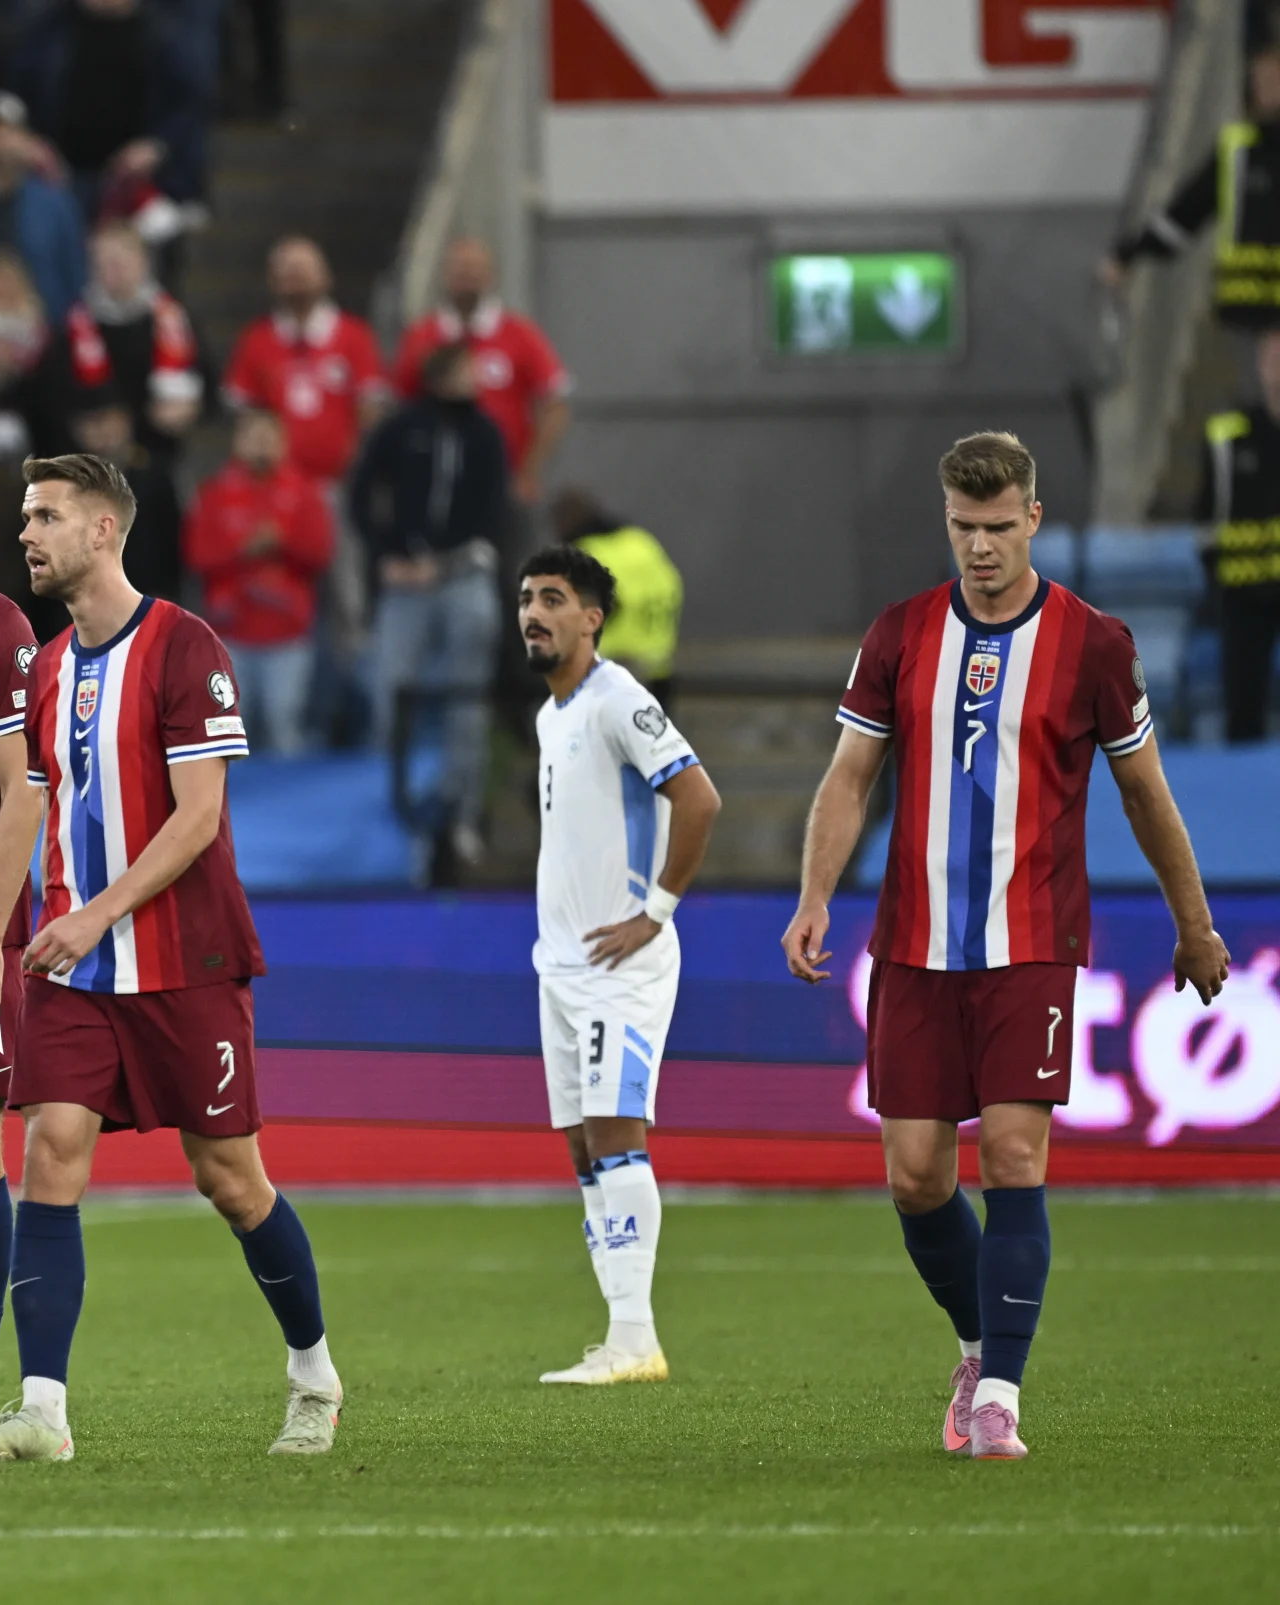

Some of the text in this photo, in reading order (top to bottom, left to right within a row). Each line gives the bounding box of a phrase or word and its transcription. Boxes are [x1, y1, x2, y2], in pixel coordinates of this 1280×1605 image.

[80, 746, 94, 802] 3
[963, 719, 988, 775] 7
[589, 1020, 605, 1065] 3
[1046, 1006, 1063, 1060] 7
[216, 1041, 235, 1095] 3
